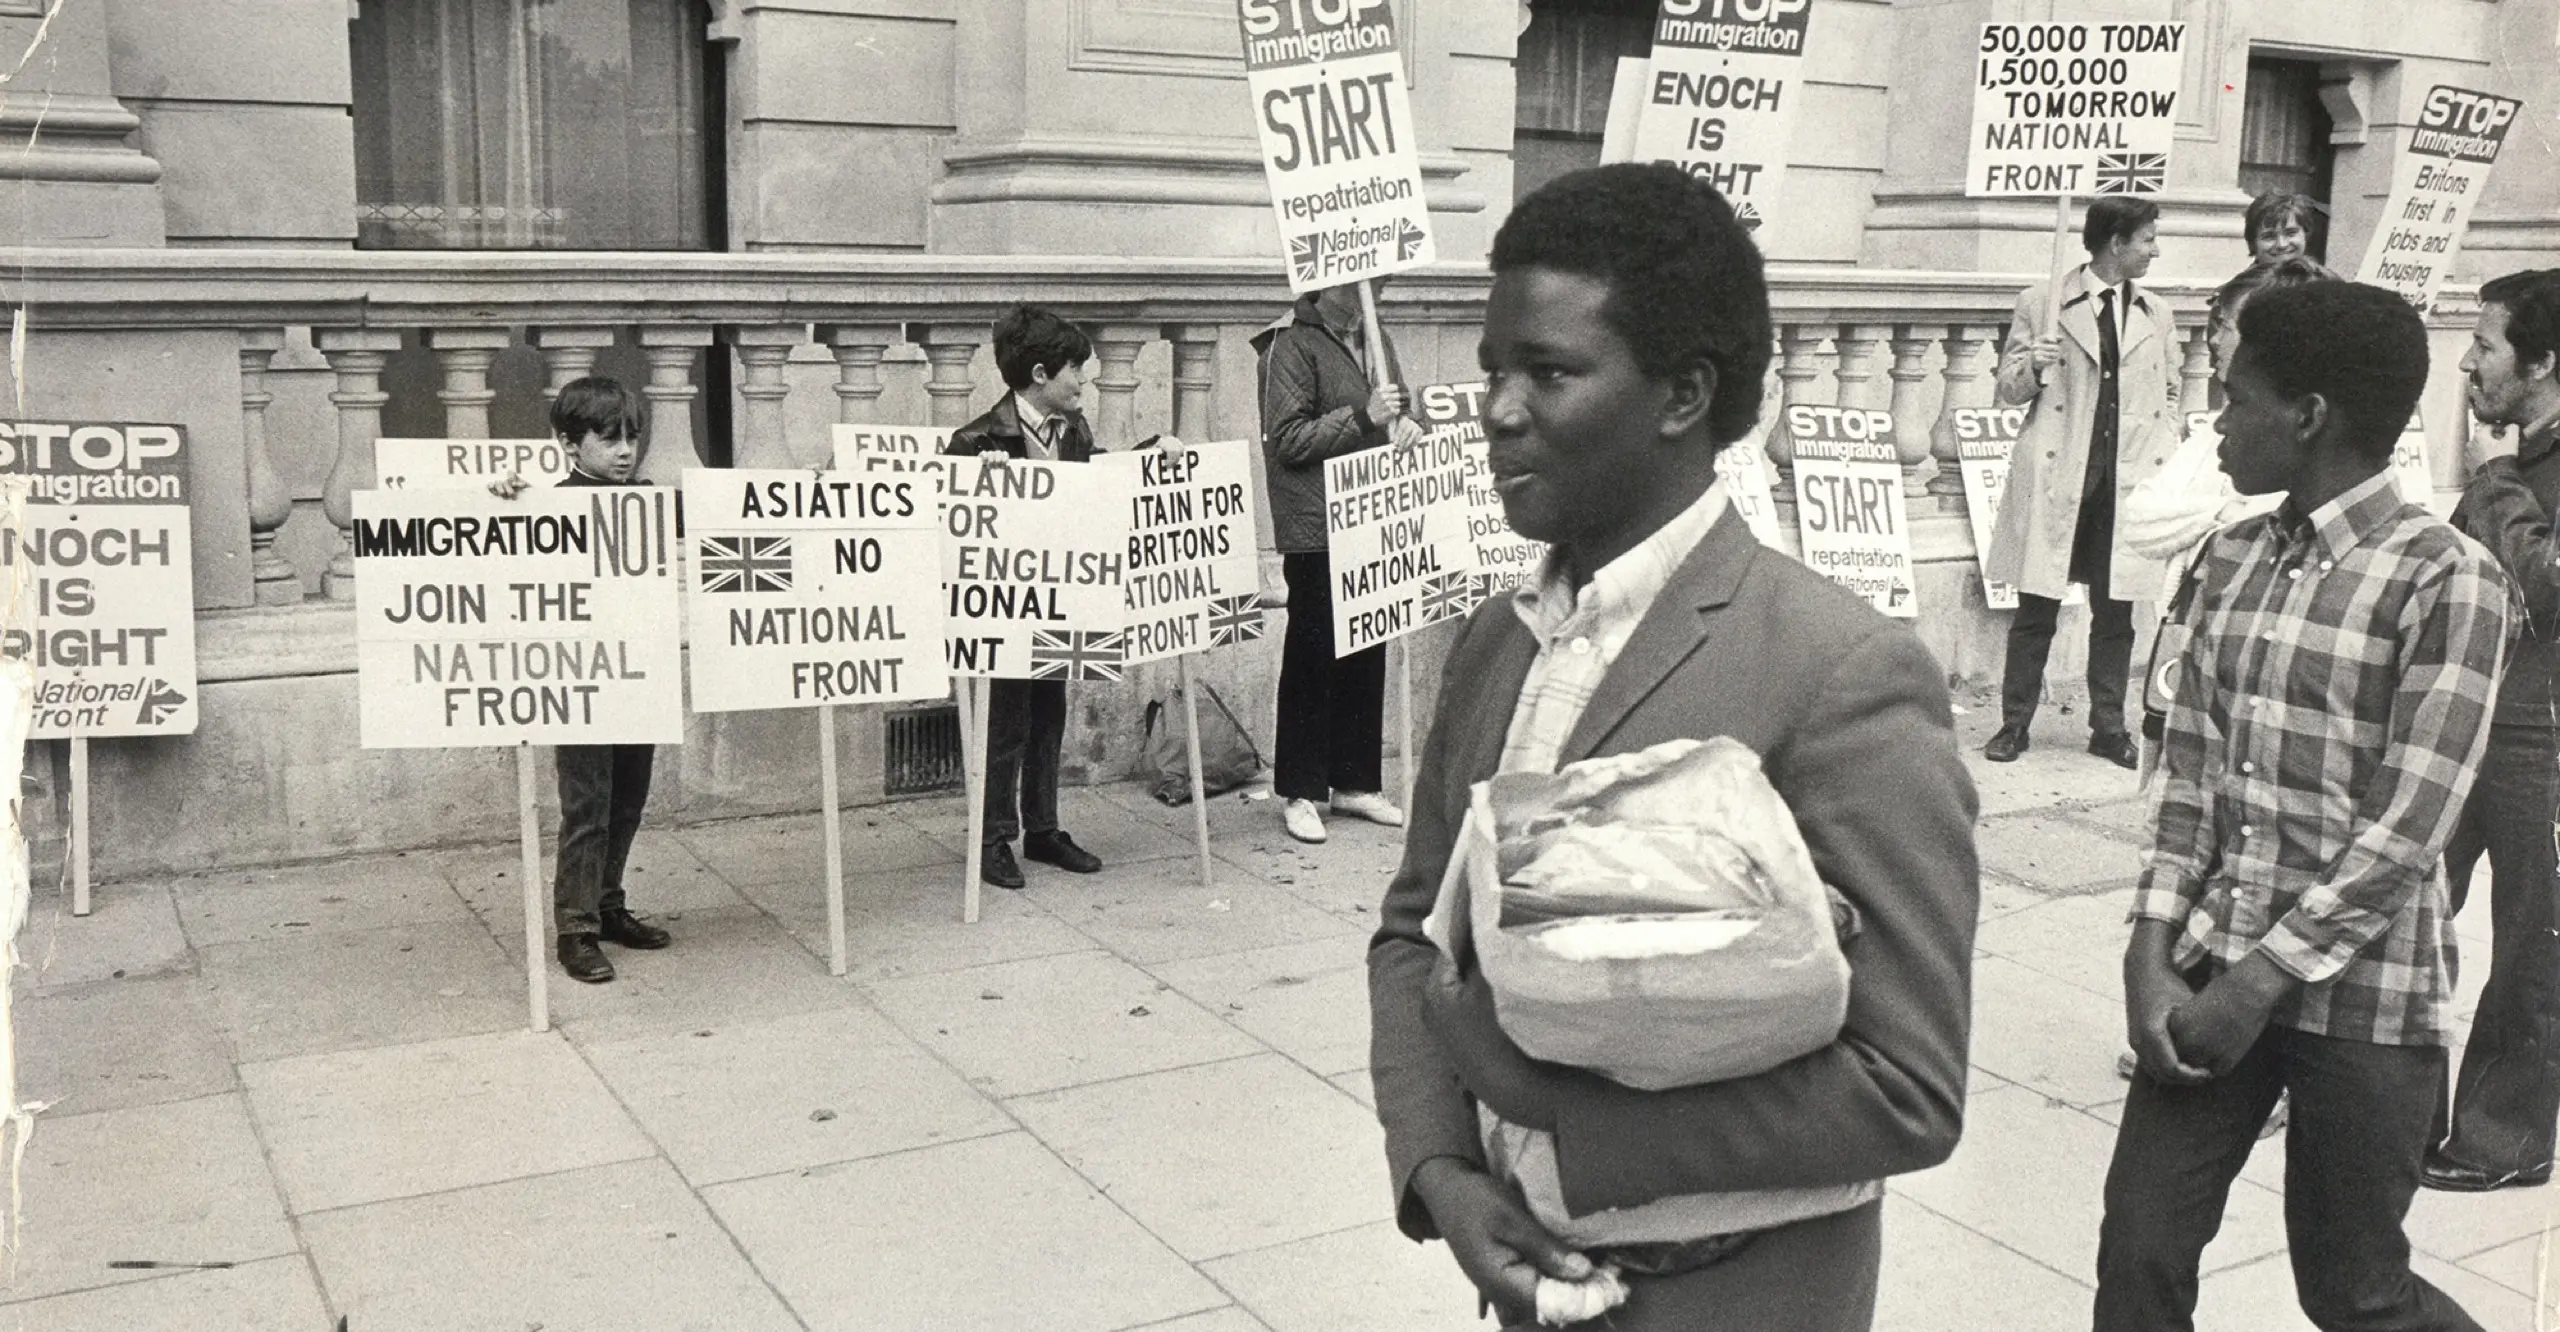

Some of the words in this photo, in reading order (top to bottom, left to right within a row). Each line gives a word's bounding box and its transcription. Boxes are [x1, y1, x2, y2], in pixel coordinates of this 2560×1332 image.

[1248, 23, 1391, 64] immigration
[1659, 18, 1799, 51] immigration
[1981, 25, 2087, 57] 50,000
[2100, 24, 2185, 53] TODAY
[1652, 70, 1783, 112] ENOCH
[1980, 58, 2127, 90] 1,500,000
[1262, 72, 1395, 172] START
[2004, 91, 2176, 118] TOMORROW
[2422, 87, 2516, 134] STOP
[1686, 117, 1726, 151] IS
[1985, 122, 2129, 150] NATIONAL
[2413, 128, 2498, 159] immigration
[1985, 164, 2084, 191] FRONT
[2414, 164, 2470, 195] Britons
[1282, 176, 1412, 222] repatriation
[2402, 196, 2436, 223] first
[2442, 201, 2457, 225] in
[1319, 218, 1396, 255] National
[2382, 226, 2419, 254] jobs
[2421, 232, 2452, 254] and
[1323, 249, 1377, 278] Front
[2376, 256, 2432, 288] housing
[1422, 382, 1489, 420] ST
[1789, 405, 1893, 440] STOP
[1955, 408, 2029, 438] STO
[1333, 431, 1463, 493] IMMIGRATION
[1795, 438, 1897, 463] immigration
[741, 481, 914, 518] ASIATICS
[1130, 489, 1193, 530] ITAIN
[1202, 483, 1244, 520] FOR
[1330, 468, 1465, 533] REFERENDUM
[1466, 484, 1501, 507] firs
[1802, 474, 1895, 535] START
[353, 514, 588, 557] IMMIGRATION
[591, 491, 667, 577] NO!
[938, 502, 999, 538] OR
[1380, 514, 1426, 555] NOW
[0, 528, 169, 567] NOCH
[835, 537, 882, 574] NO
[958, 546, 1122, 586] ENGLISH
[1128, 524, 1230, 570] BRITONS
[1811, 546, 1904, 570] repatriation
[1124, 564, 1222, 611] ATIONAL
[1341, 544, 1441, 602] NATIONAL
[40, 578, 95, 616] IS
[384, 584, 487, 624] JOIN
[509, 583, 592, 621] THE
[729, 605, 906, 646] NATIONAL
[1123, 613, 1200, 660] FRONT
[1349, 598, 1414, 648] FRONT
[413, 641, 646, 683] NATIONAL
[792, 657, 903, 699] FRONT
[444, 685, 600, 727] FRONT
